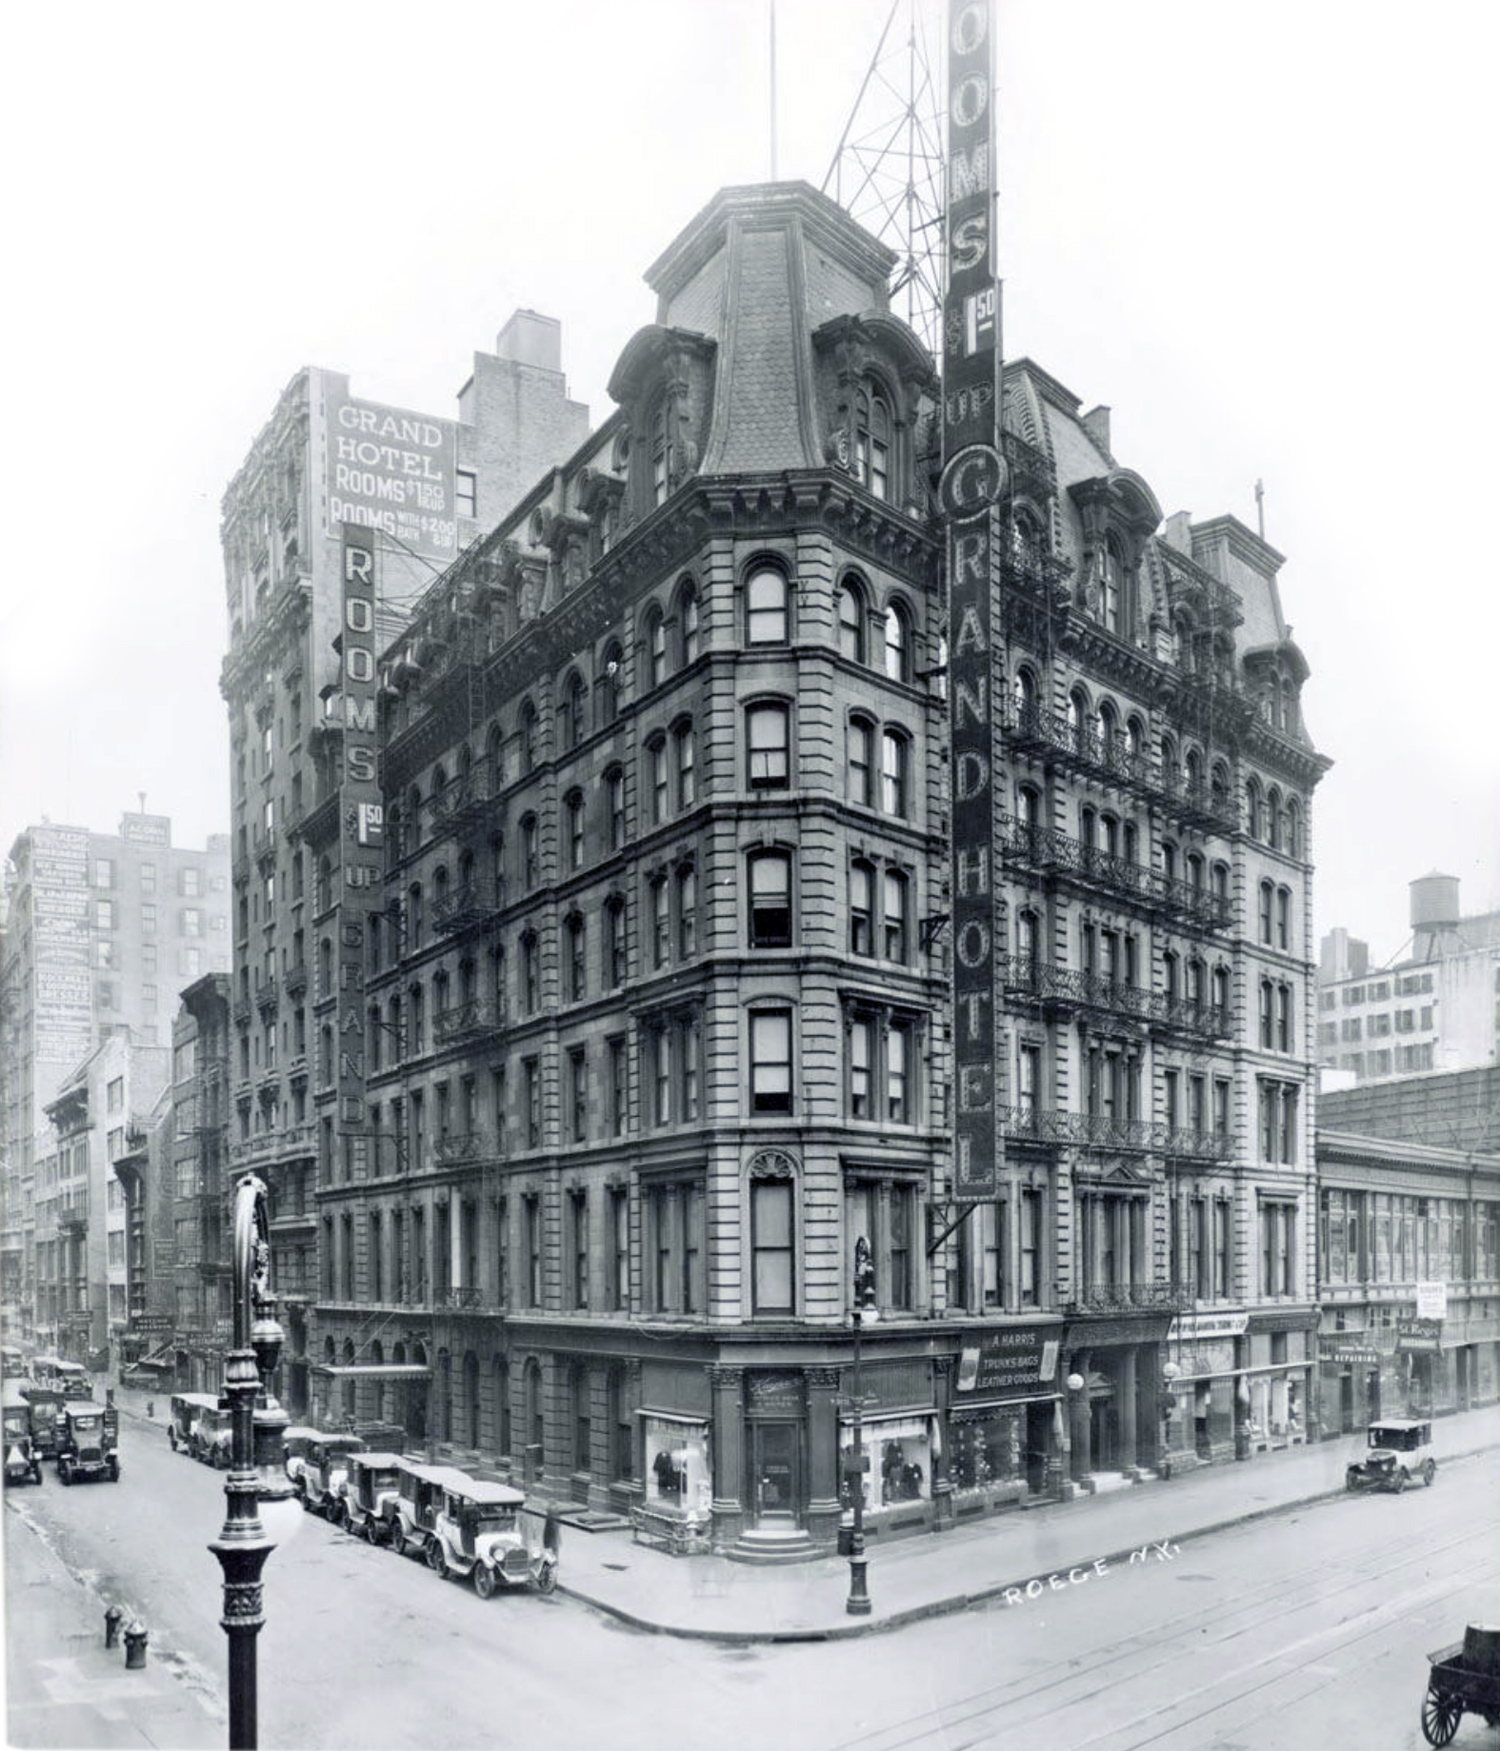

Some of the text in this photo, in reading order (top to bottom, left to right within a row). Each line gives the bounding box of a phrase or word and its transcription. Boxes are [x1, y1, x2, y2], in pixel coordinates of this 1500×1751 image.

[946, 382, 993, 426] UP
[338, 406, 442, 447] GRAND
[336, 436, 443, 481] HOTEL
[336, 463, 406, 503] ROOMS
[330, 496, 395, 535] ROOMS
[951, 457, 989, 798] GRAND
[345, 546, 375, 781] ROOMS
[346, 863, 382, 889] UP
[341, 924, 364, 1123] GRAND
[956, 843, 993, 1187] HOTEL
[1002, 1333, 1036, 1346] HARRIS
[977, 1373, 1039, 1388] LEATHER GOODS
[983, 1355, 1039, 1370] TRUNKS BAGS
